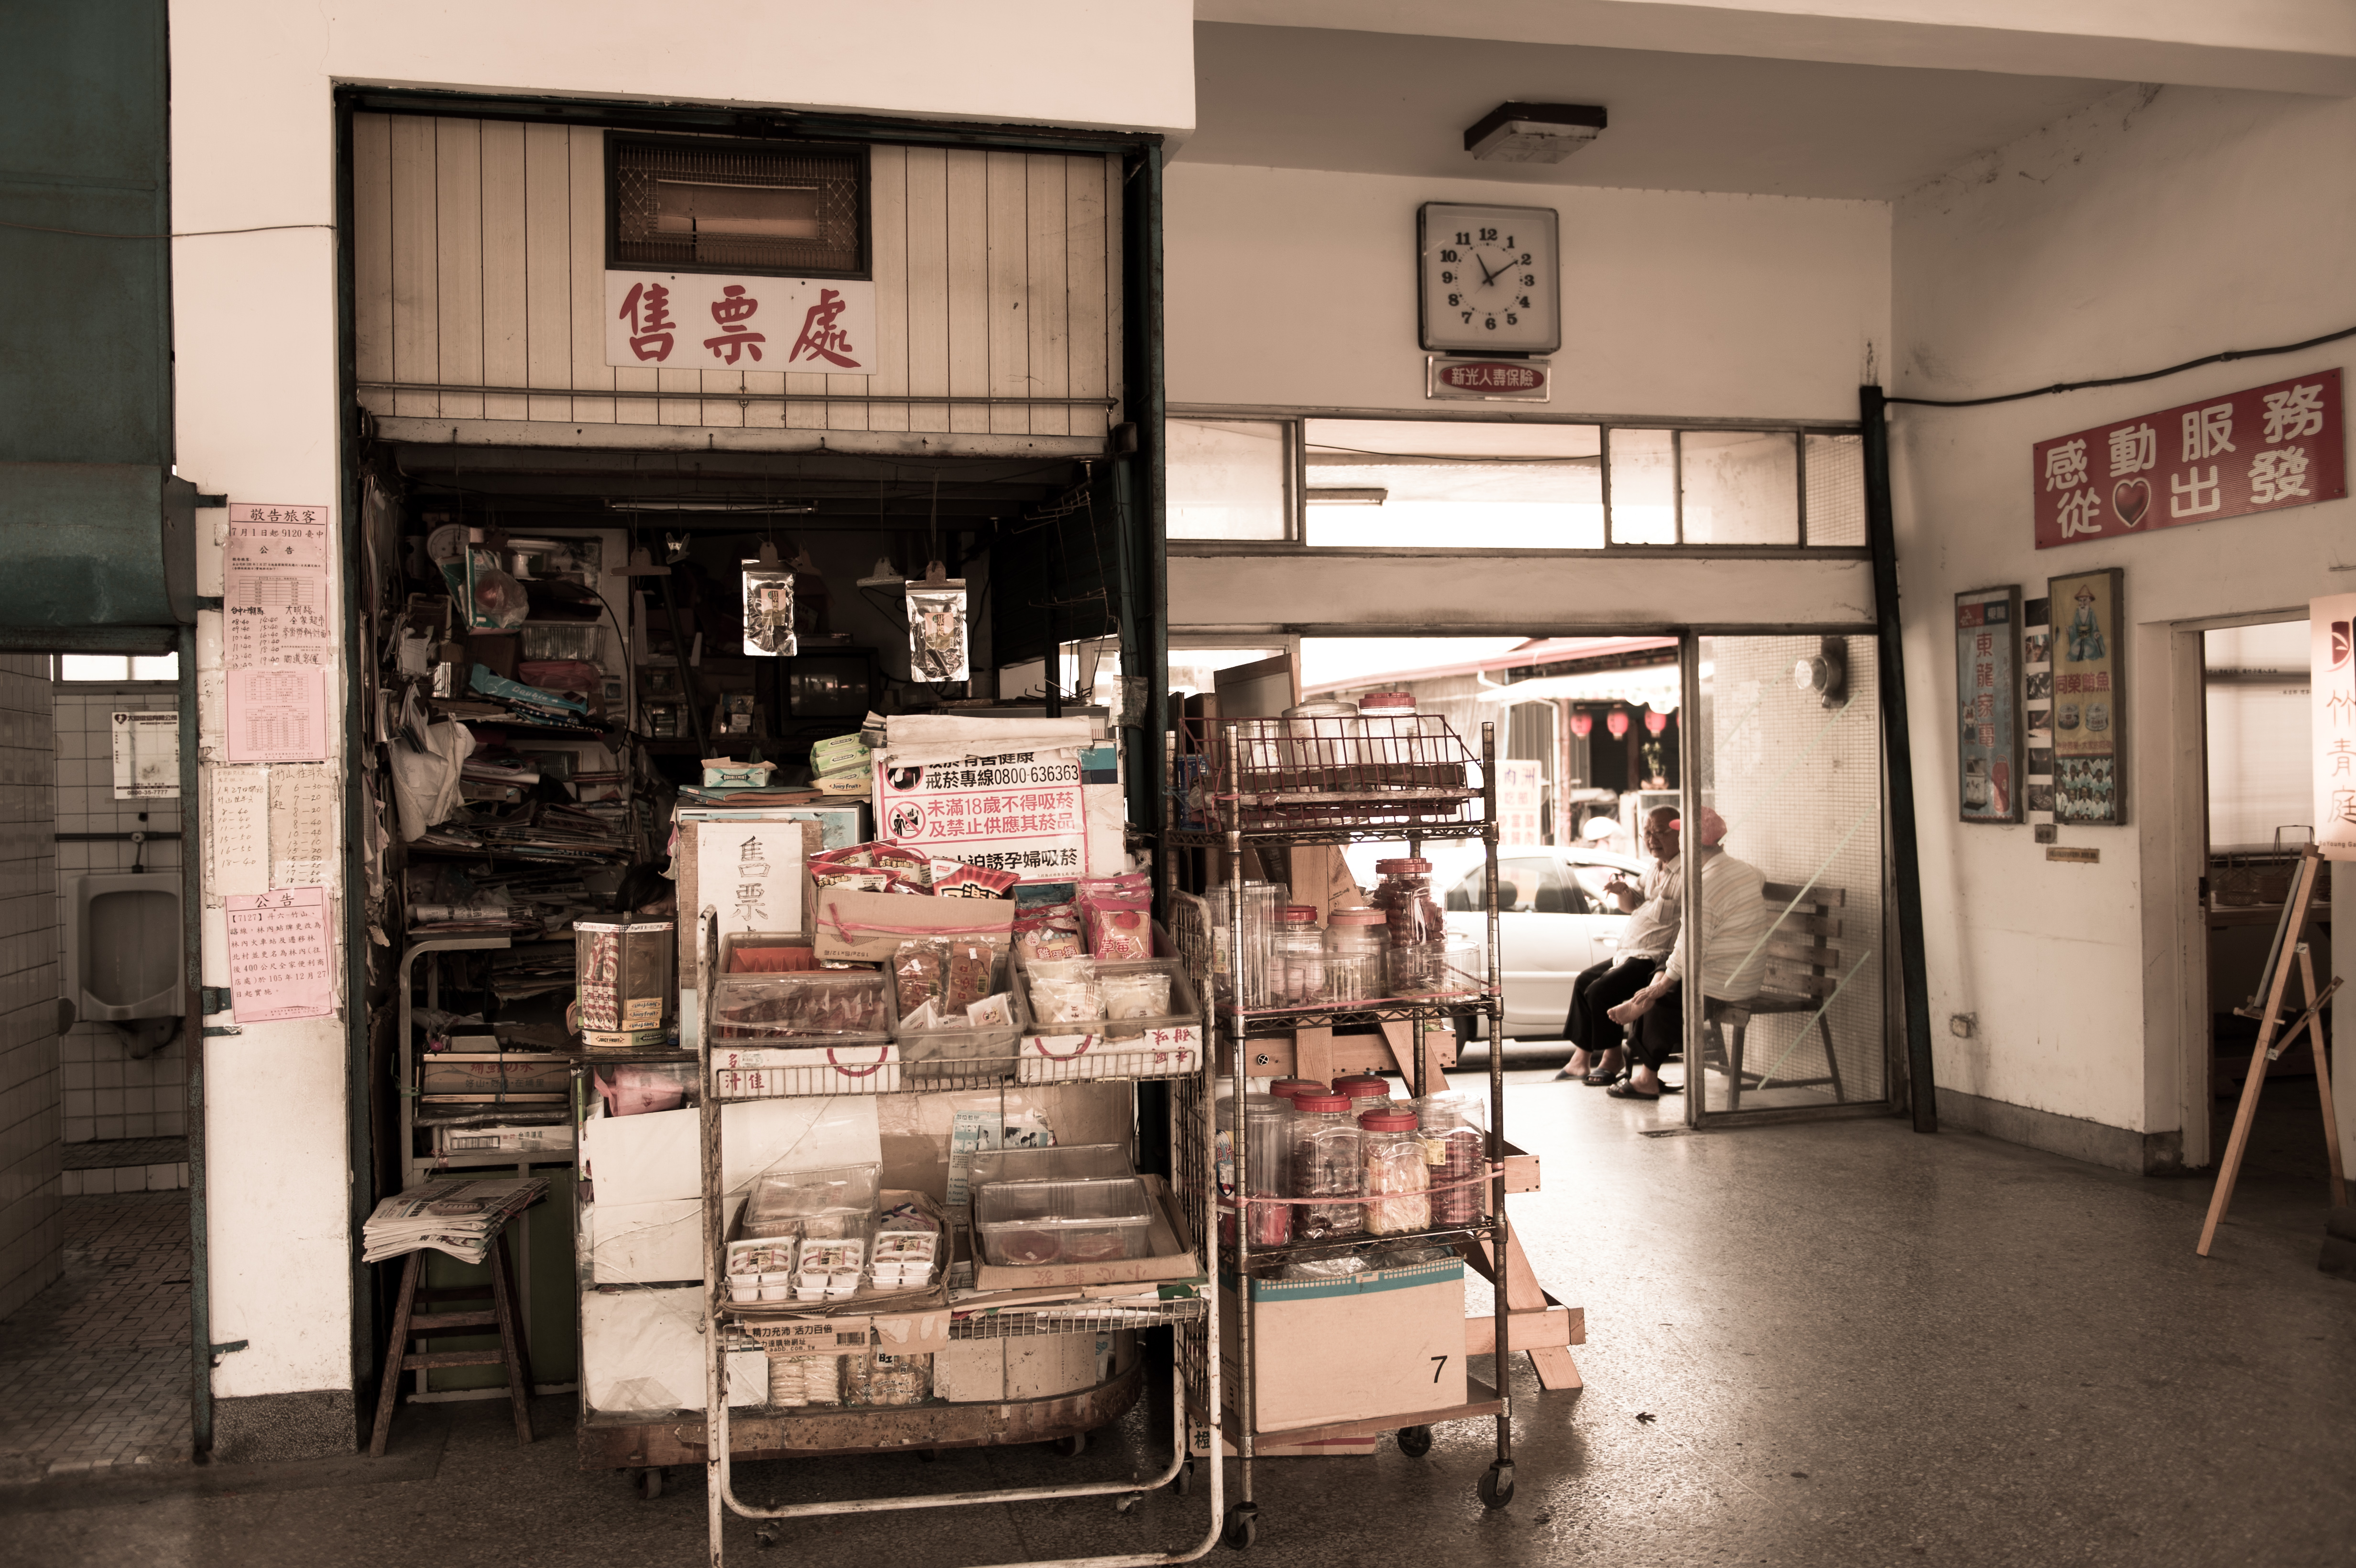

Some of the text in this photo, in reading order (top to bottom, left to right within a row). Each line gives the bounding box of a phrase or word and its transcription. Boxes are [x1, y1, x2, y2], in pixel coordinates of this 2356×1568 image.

[1455, 232, 1471, 245] 11
[1479, 229, 1497, 240] 12
[1507, 236, 1515, 248] 1
[1440, 250, 1457, 262] 10
[1521, 254, 1531, 265] 2
[1441, 272, 1453, 283] 9
[1525, 275, 1534, 286] 3
[1448, 294, 1459, 306] 8
[1519, 296, 1530, 308] 4
[1462, 312, 1472, 324] 7
[1485, 318, 1496, 329] 6
[1507, 313, 1517, 325] 5
[619, 283, 861, 368] 售票處
[1451, 368, 1534, 387] 新光人壽保險
[2045, 384, 2323, 492] 感動服務
[251, 509, 316, 523] 敬告旅客
[260, 546, 294, 554] 公告
[290, 615, 325, 627] 全家超市
[233, 644, 251, 652] 11:40
[512, 686, 547, 700] Double
[1976, 633, 1994, 748] 東龍家電
[276, 768, 326, 781] 竹山往斗六
[926, 765, 1079, 791] 戒菸專線0800-636363
[928, 792, 1074, 817] 未滿18歲不得吸菸
[929, 812, 1075, 838] 及禁止供應其菸品
[942, 849, 1077, 870] 迫誘孕婦吸菸
[729, 835, 771, 931] 售票
[255, 893, 294, 908] 公告
[1101, 939, 1130, 953] 草莓
[1033, 1264, 1146, 1285] 小心輕放
[753, 1324, 832, 1337] 精力充沛 活力百倍
[1430, 1355, 1448, 1383] 7
